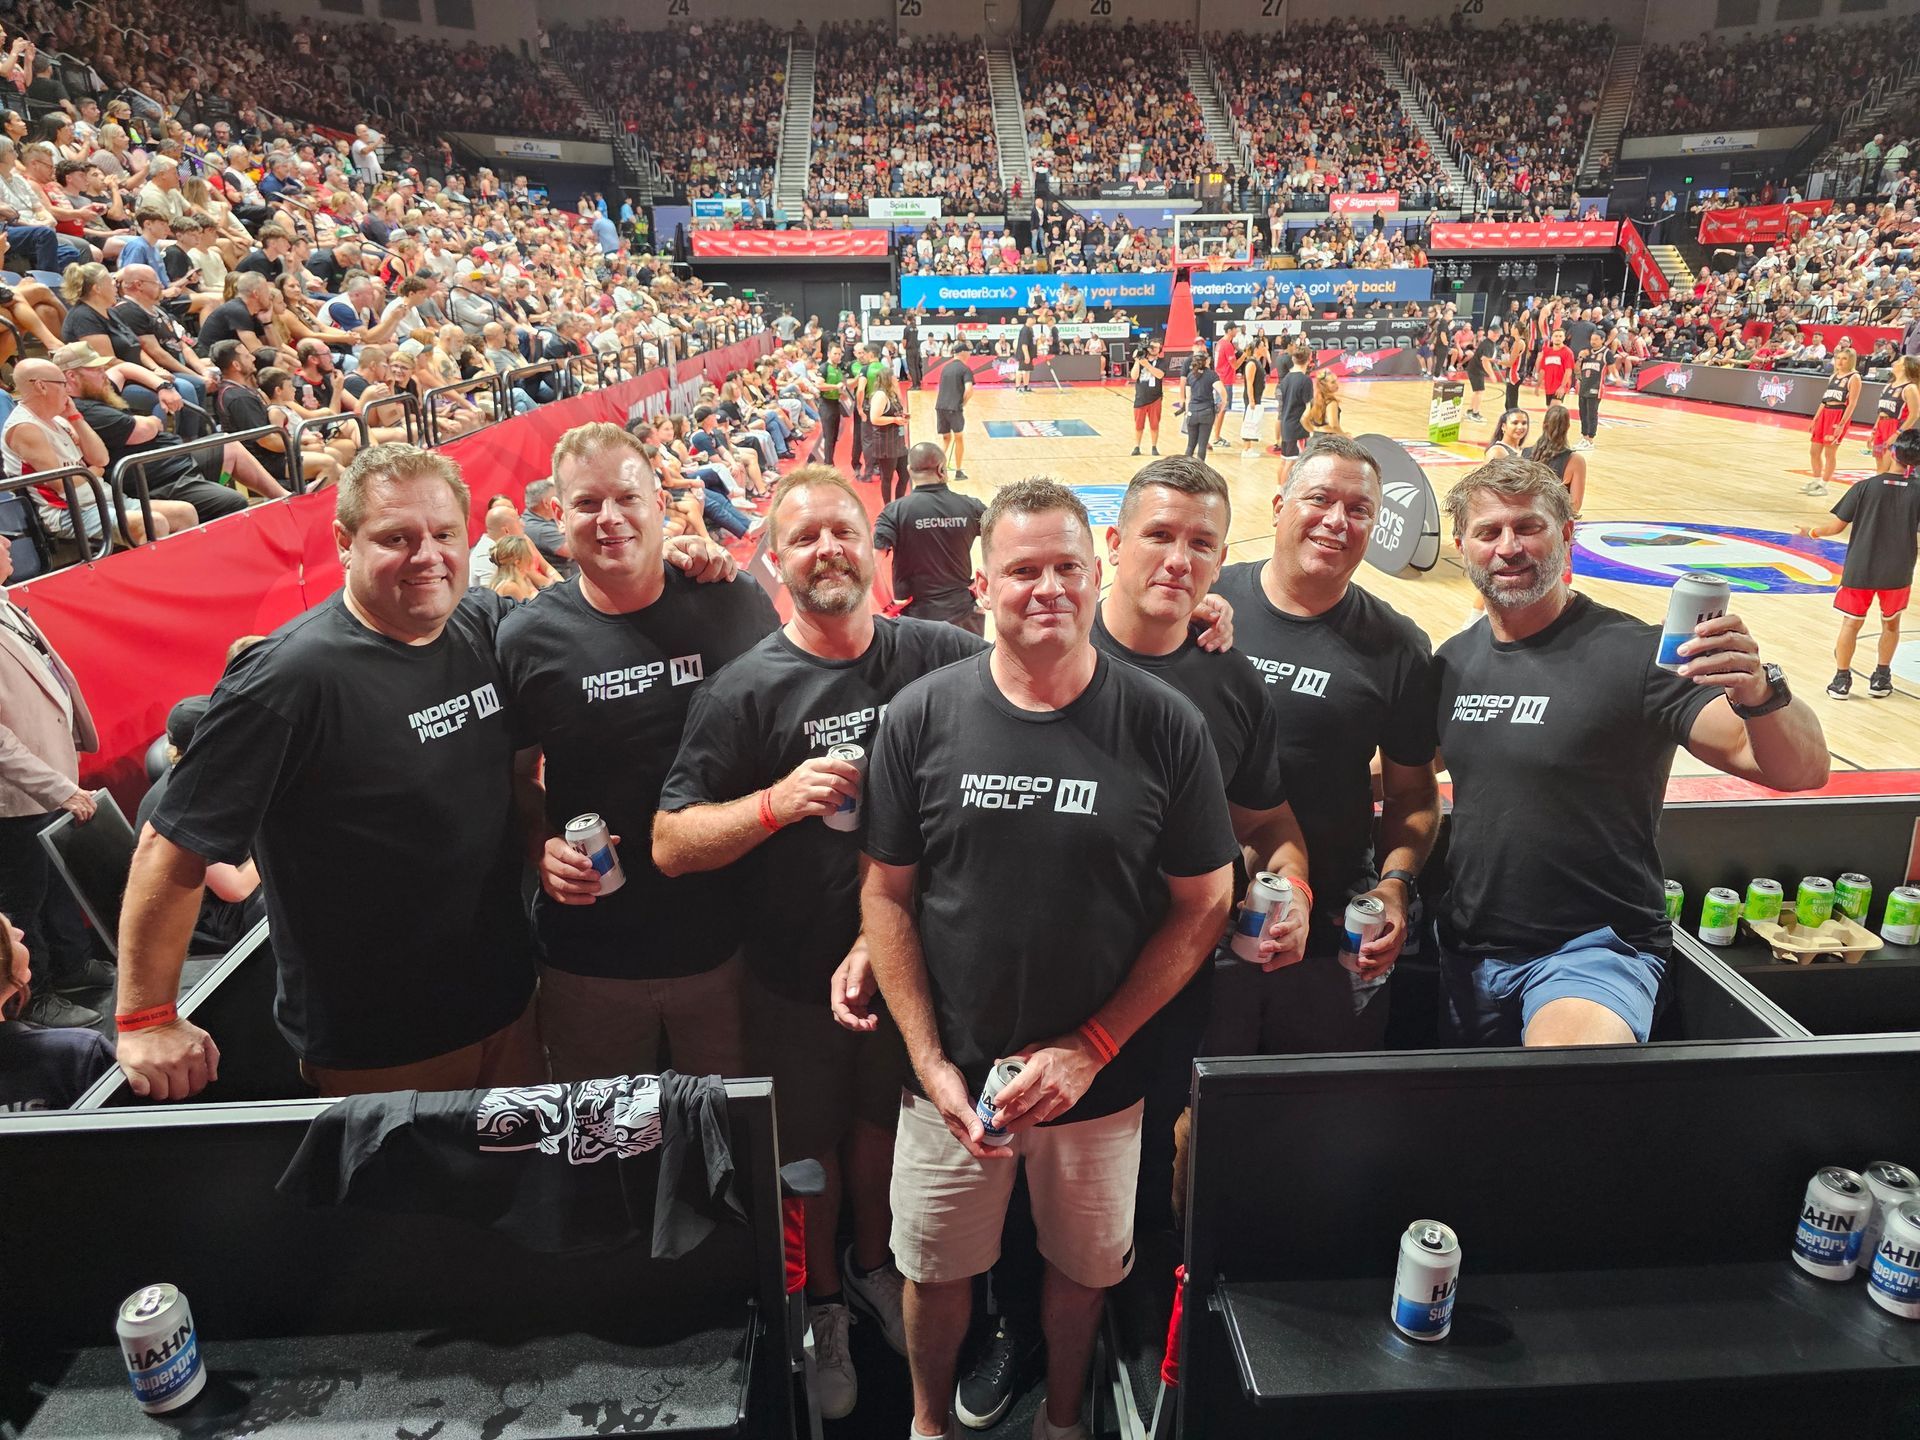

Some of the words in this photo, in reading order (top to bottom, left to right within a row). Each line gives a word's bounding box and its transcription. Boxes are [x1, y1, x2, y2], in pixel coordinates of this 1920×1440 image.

[668, 0, 690, 15] 24
[900, 0, 921, 16] 25
[1261, 0, 1283, 16] 27
[1349, 198, 1395, 208] Signarma
[939, 286, 1009, 299] GreaterBank
[1091, 287, 1117, 299] your
[1120, 284, 1155, 296] back!
[1309, 281, 1330, 296] got
[1333, 282, 1359, 295] yr
[1361, 280, 1396, 292] back!
[1760, 383, 1786, 402] HAWKS
[915, 516, 968, 531] SECURITY
[1379, 507, 1405, 537] ors
[1246, 655, 1296, 676] DIGO
[582, 661, 664, 690] INDIGO
[1454, 694, 1516, 709] INDIGO
[408, 694, 470, 730] INDIGO
[803, 707, 875, 735] INDIGO
[960, 774, 1053, 793] INDIGO
[1797, 1227, 1848, 1252] perDry
[1879, 1235, 1920, 1268] AH
[128, 1316, 192, 1371] HAHN
[169, 1367, 191, 1389] CARB
